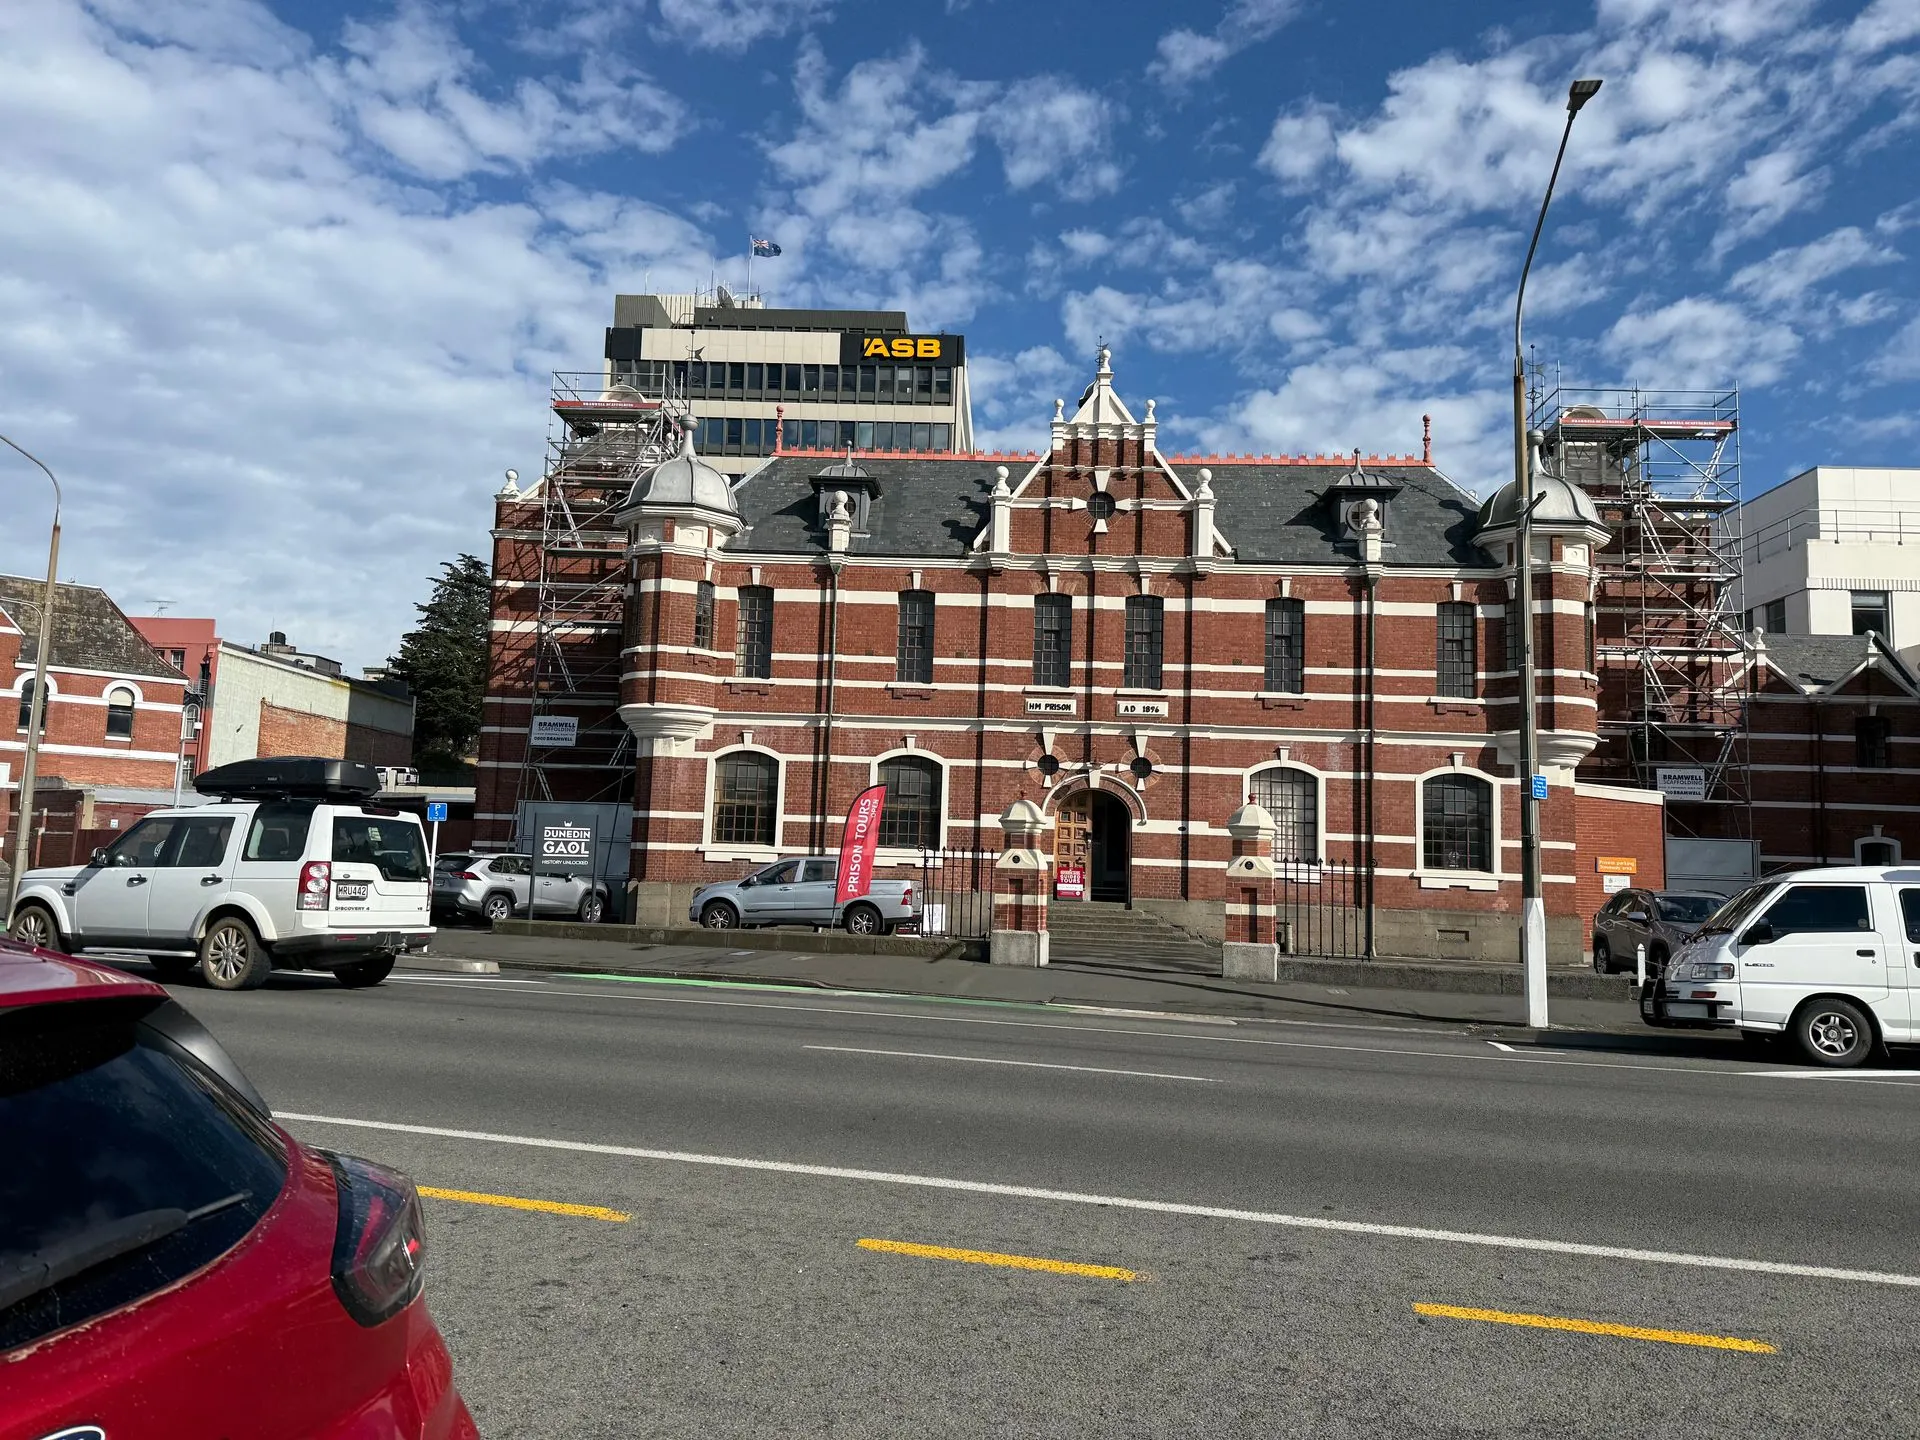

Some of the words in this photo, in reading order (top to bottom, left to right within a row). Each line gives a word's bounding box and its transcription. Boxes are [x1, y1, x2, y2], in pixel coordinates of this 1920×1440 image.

[864, 338, 941, 358] ASB
[1045, 703, 1071, 711] PRISON
[1123, 705, 1136, 713] AD
[1142, 705, 1160, 713] 1896
[870, 799, 879, 818] OPEN
[855, 799, 870, 839] TOURS
[544, 830, 590, 838] DUNEDIN
[543, 841, 589, 854] GAOL
[848, 845, 863, 892] PRISON
[338, 886, 366, 896] MRU442
